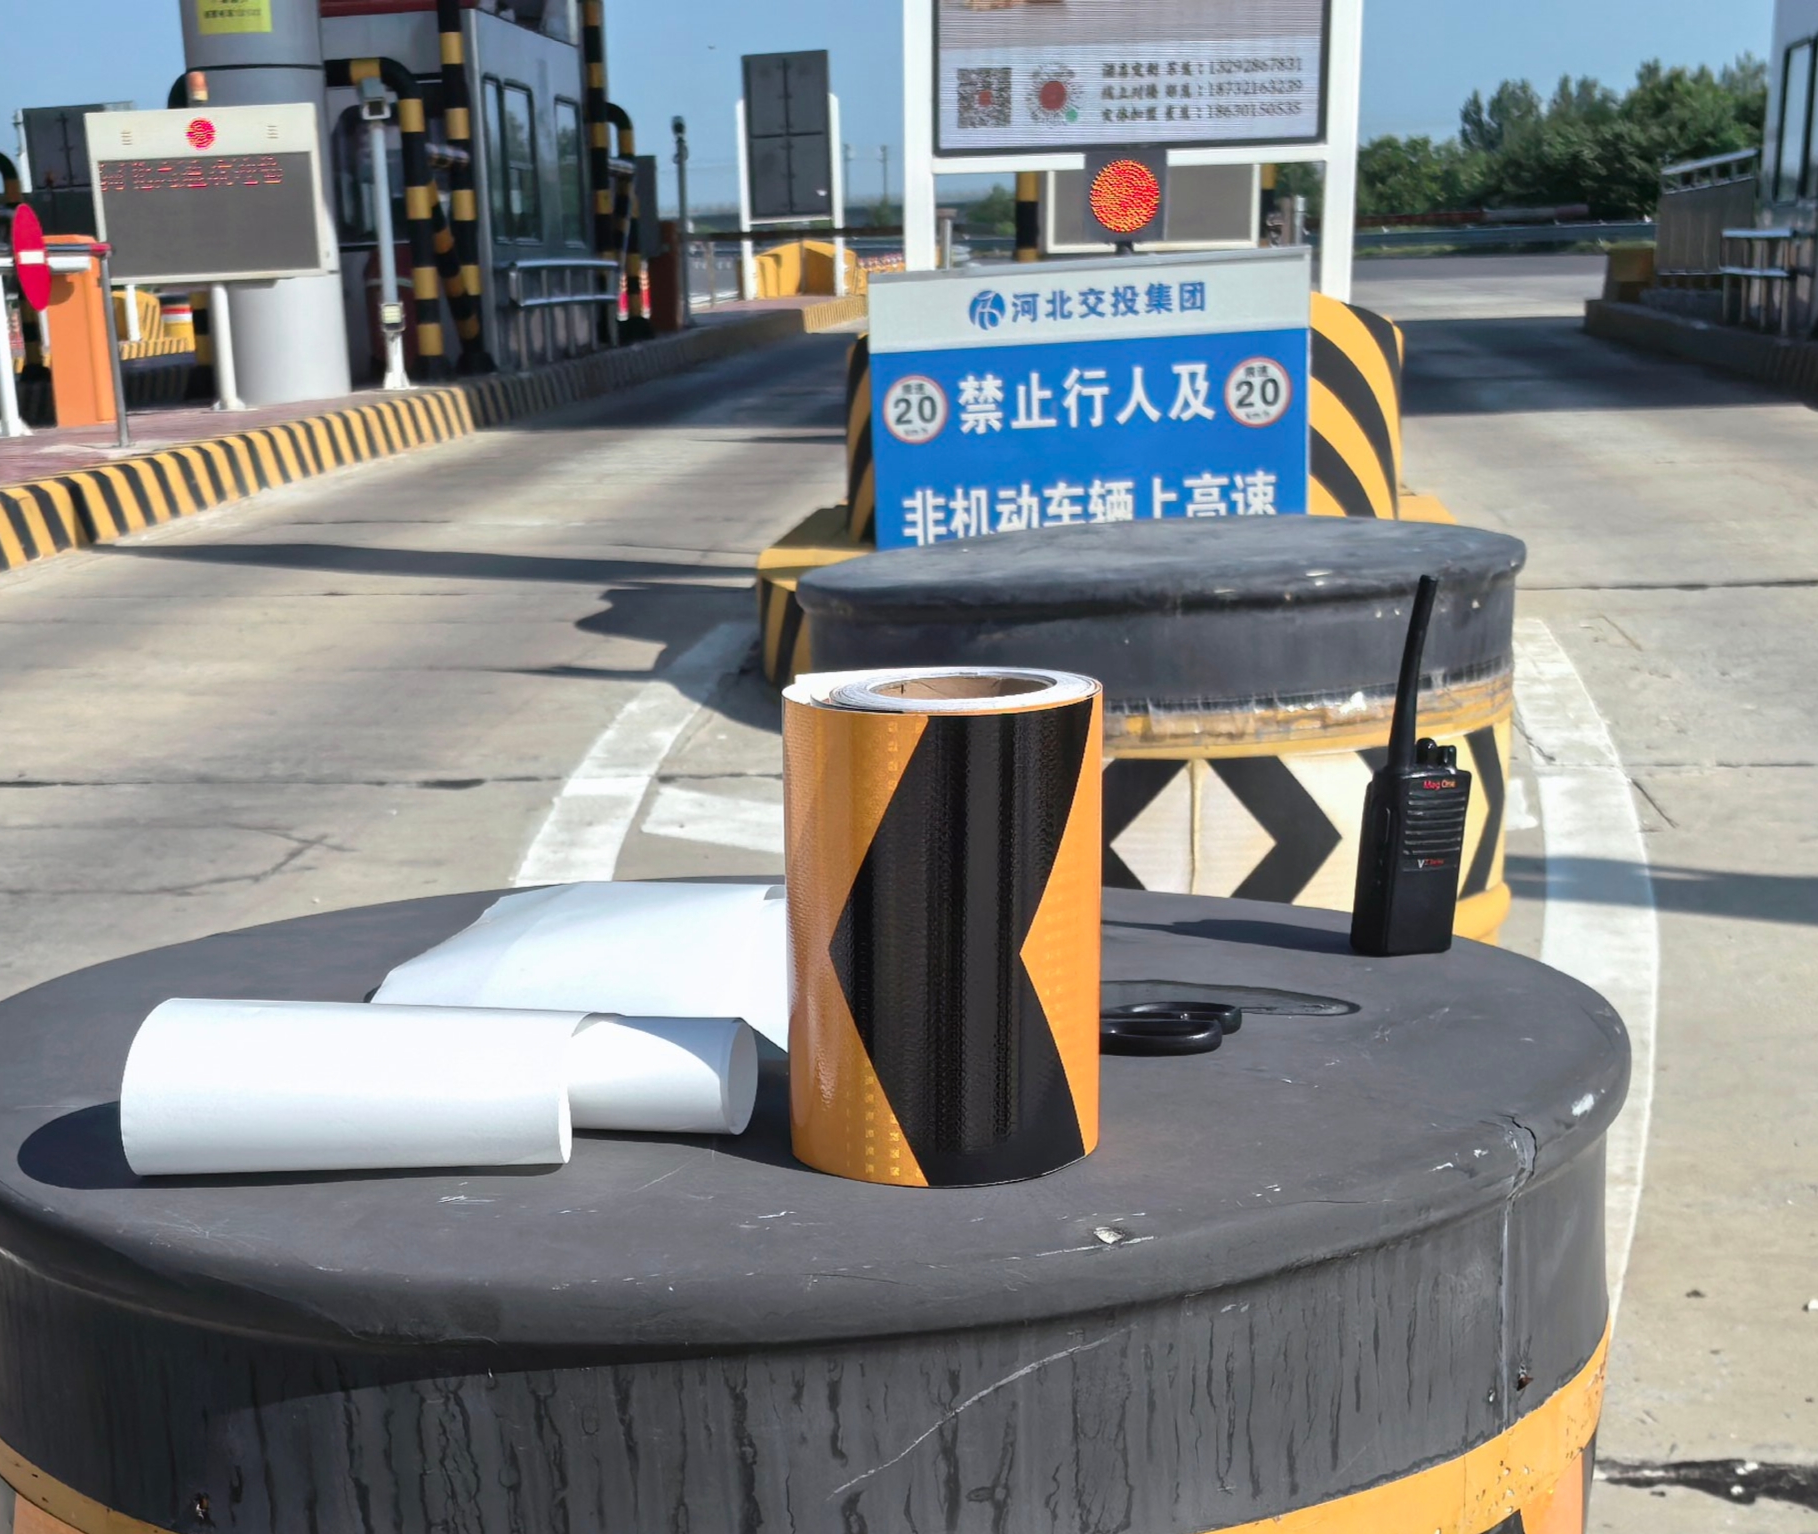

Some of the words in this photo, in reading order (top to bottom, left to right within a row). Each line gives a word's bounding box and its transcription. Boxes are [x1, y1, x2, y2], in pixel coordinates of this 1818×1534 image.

[1011, 281, 1206, 323] 河北交投集团
[958, 364, 1216, 435] 禁止行人及
[1235, 378, 1280, 409] 20
[894, 396, 938, 426] 20
[1423, 780, 1441, 790] Mag
